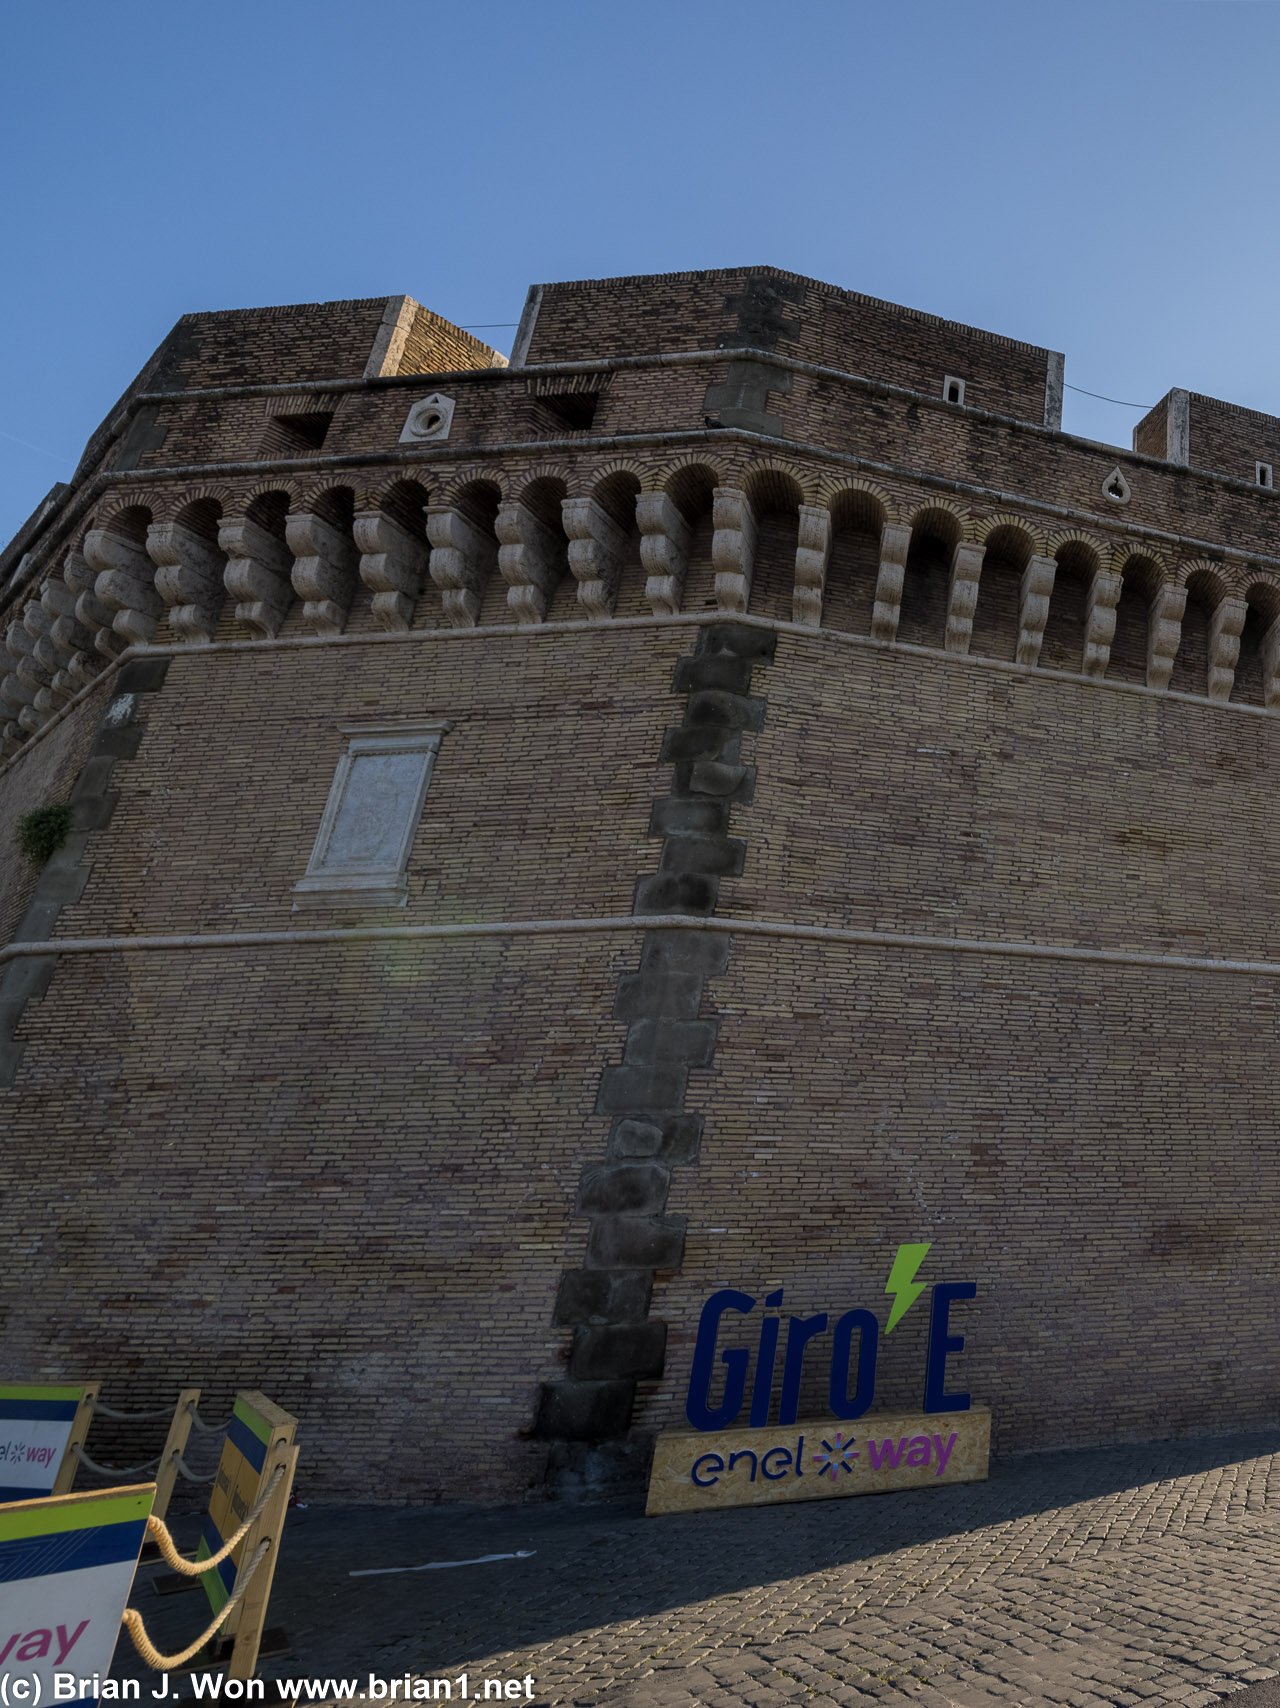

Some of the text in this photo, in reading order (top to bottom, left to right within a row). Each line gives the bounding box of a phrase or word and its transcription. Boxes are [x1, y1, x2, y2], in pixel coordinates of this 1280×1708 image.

[686, 1282, 977, 1431] Giro E
[26, 1447, 57, 1469] way
[691, 1432, 959, 1487] enel way
